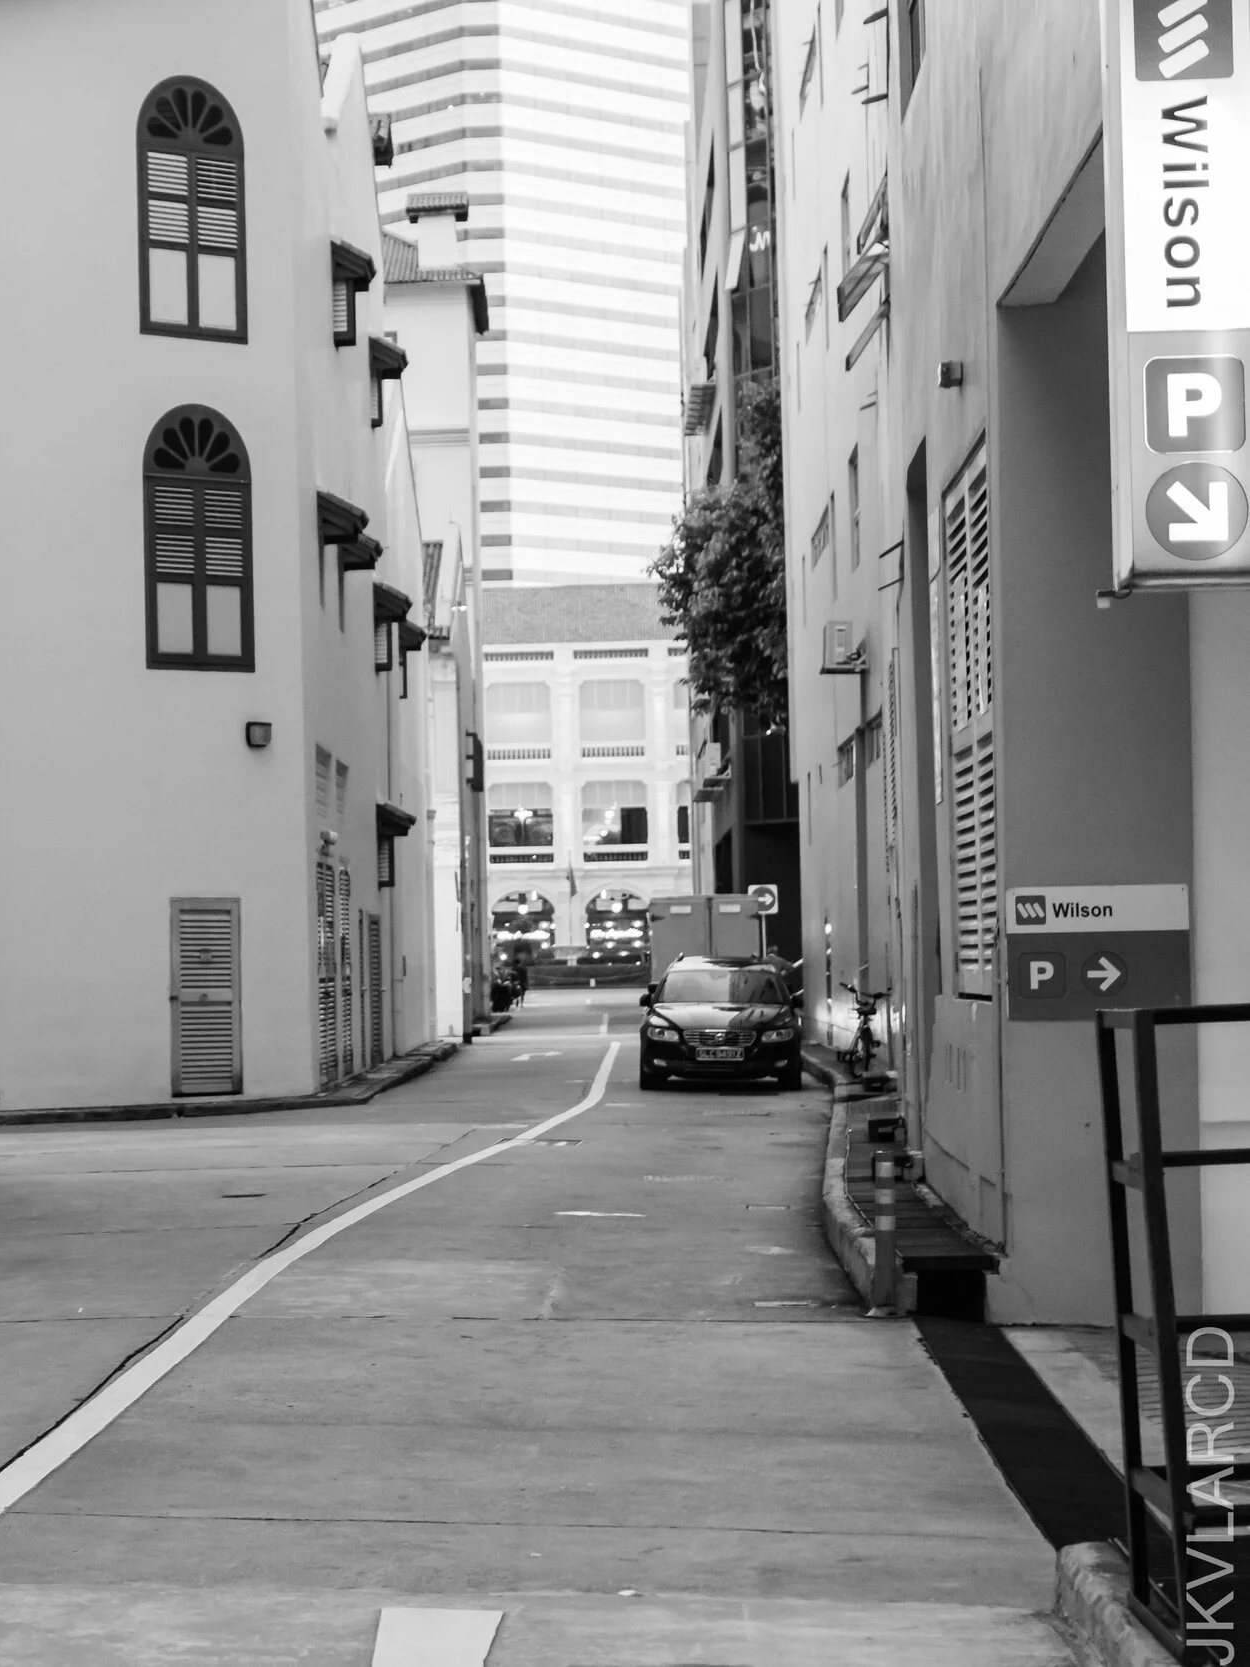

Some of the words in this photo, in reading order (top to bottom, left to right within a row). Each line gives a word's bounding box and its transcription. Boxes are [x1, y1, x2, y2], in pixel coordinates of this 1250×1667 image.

[1160, 95, 1210, 308] Wilson
[1166, 372, 1222, 437] P
[1052, 902, 1113, 918] Wilson
[1029, 960, 1055, 990] P
